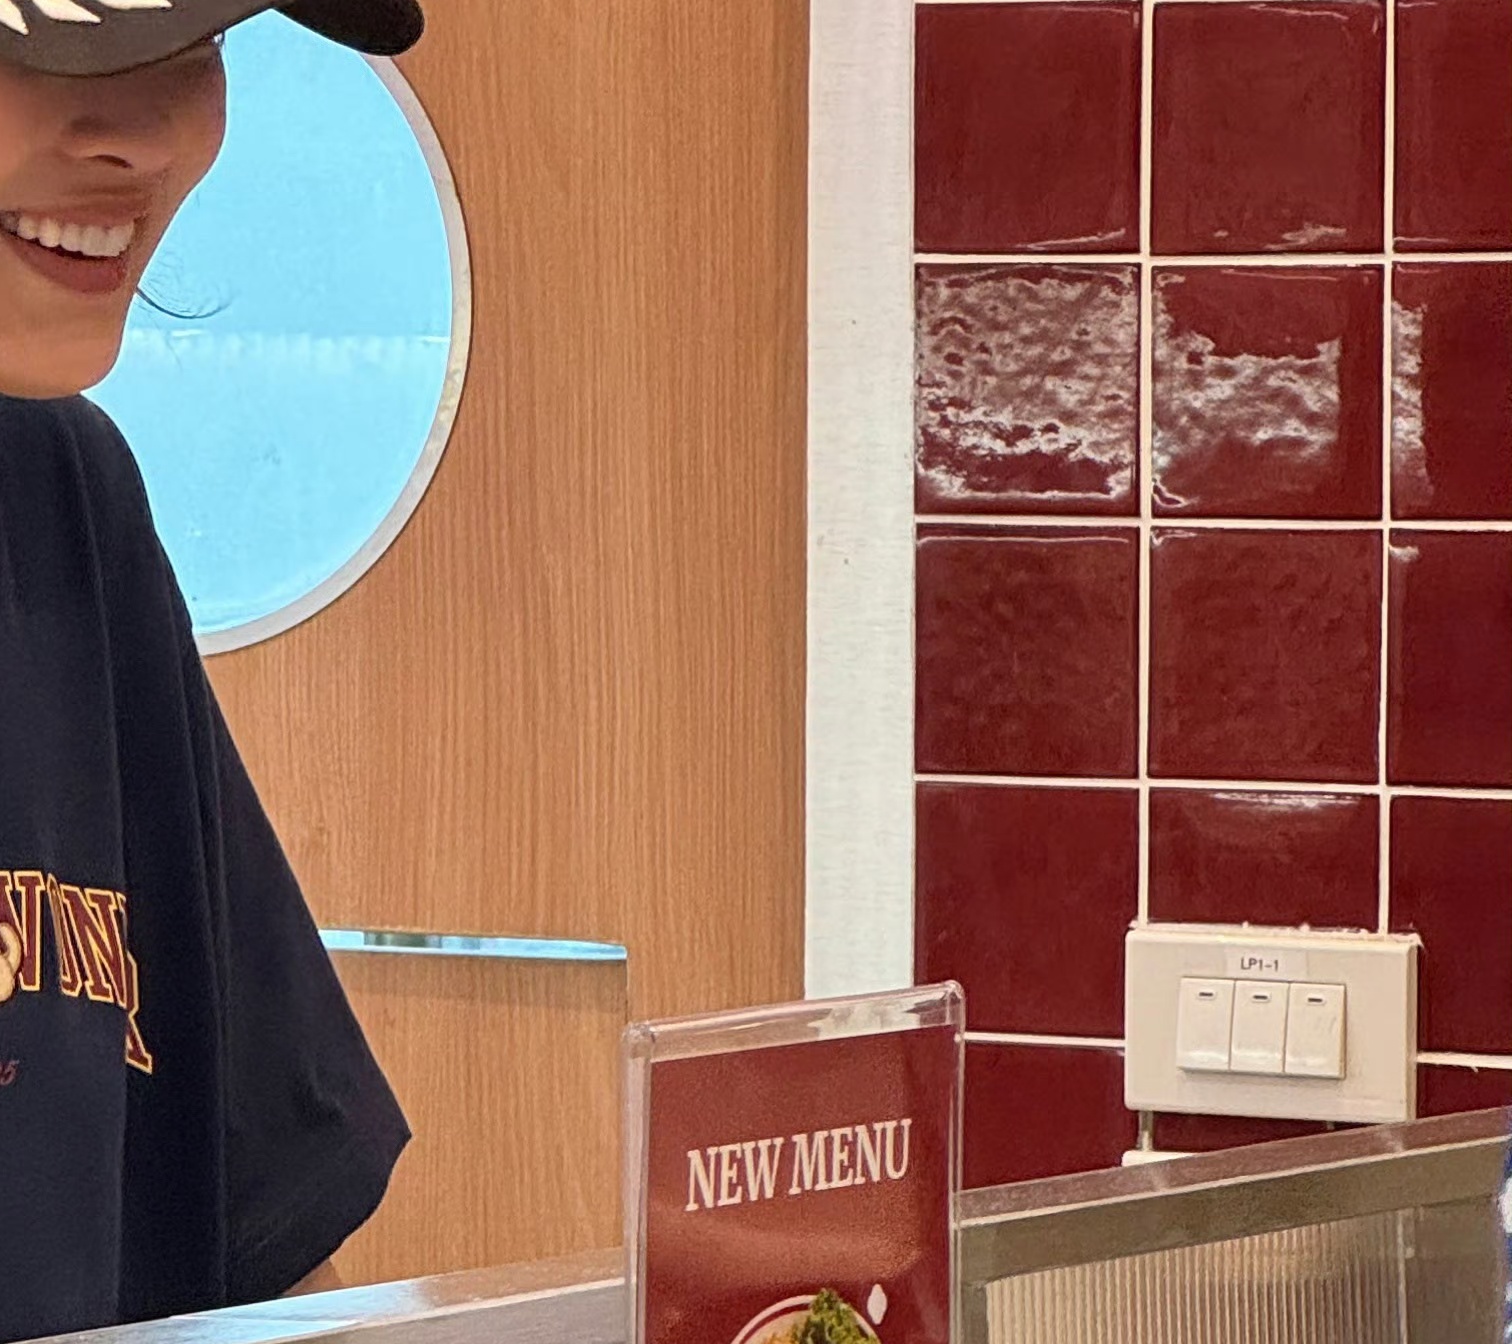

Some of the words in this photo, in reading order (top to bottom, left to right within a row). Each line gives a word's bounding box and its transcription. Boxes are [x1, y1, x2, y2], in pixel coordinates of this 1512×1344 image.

[1240, 956, 1279, 972] LP1-1
[684, 1136, 785, 1212] NEW
[788, 1118, 913, 1196] MENU
